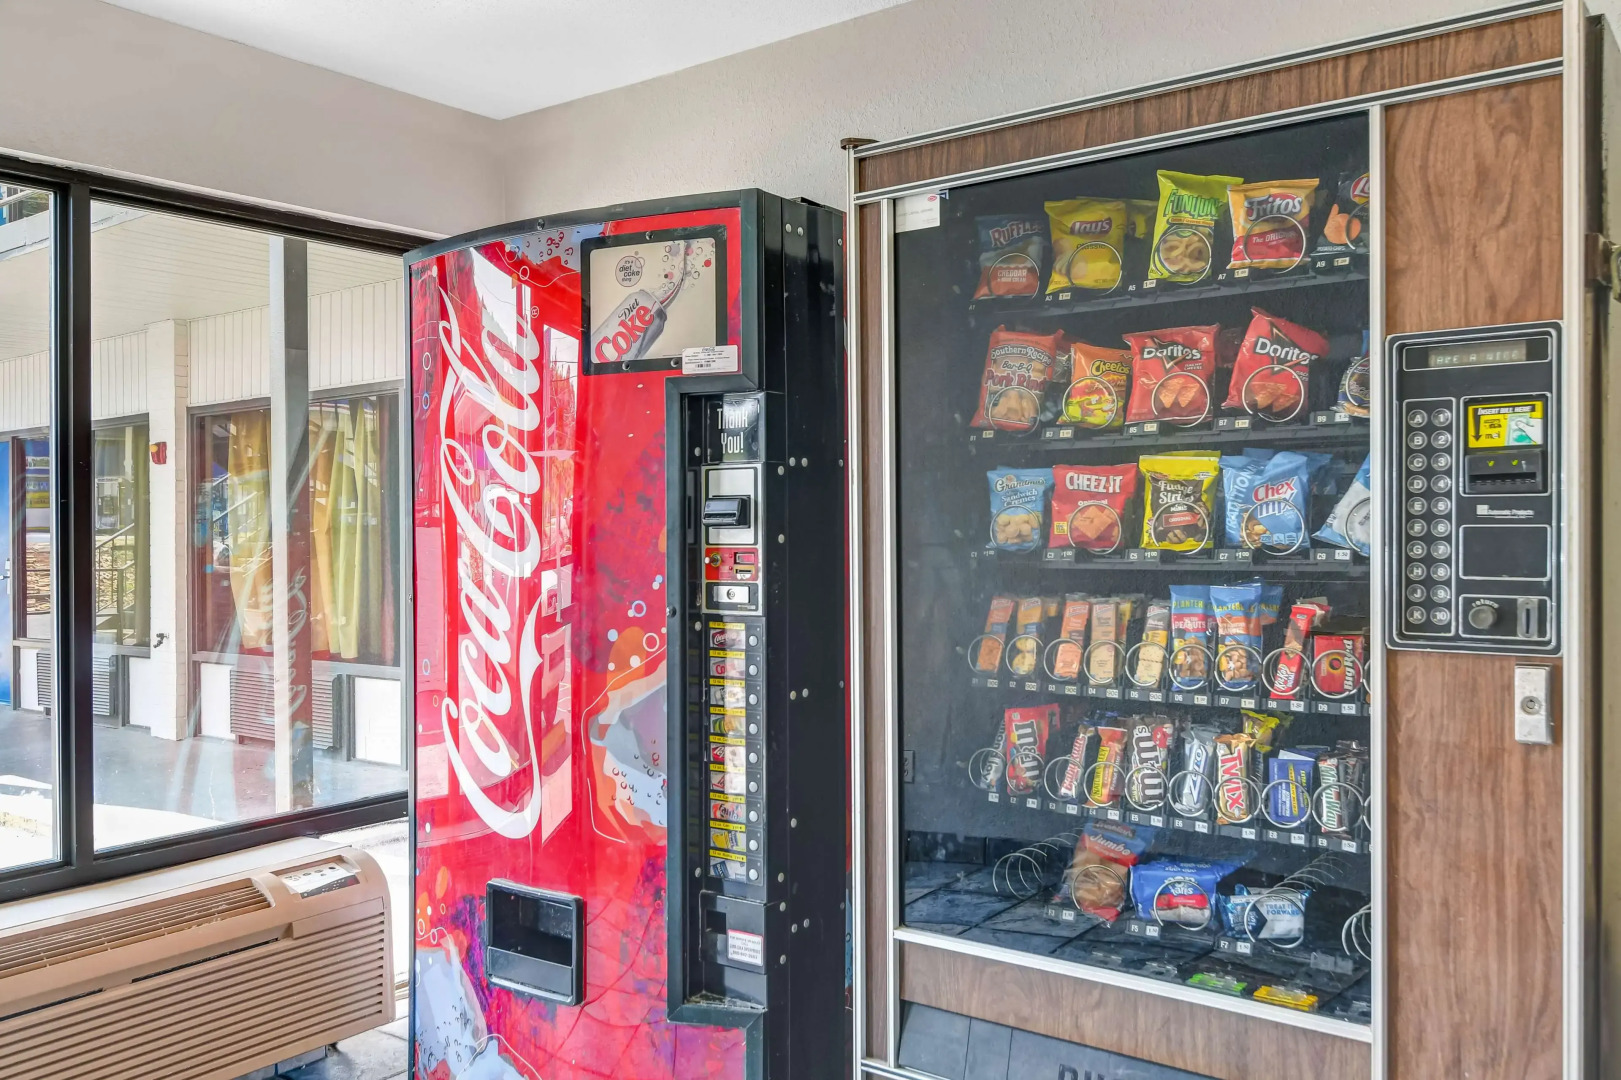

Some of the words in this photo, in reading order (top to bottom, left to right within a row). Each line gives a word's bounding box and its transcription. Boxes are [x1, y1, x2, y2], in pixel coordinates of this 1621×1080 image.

[1244, 195, 1302, 220] Fritos
[1074, 218, 1111, 234] Lay's
[997, 269, 1027, 277] CHEDDAR
[618, 298, 640, 320] Diet
[595, 304, 655, 362] Coke
[991, 346, 1027, 360] Southern
[1026, 346, 1053, 366] Recipe
[1143, 344, 1201, 360] Doritos
[1001, 360, 1033, 374] Bar-B-Q
[1091, 359, 1130, 375] Cheetos
[985, 368, 1016, 388] Pork
[1478, 407, 1500, 416] INSERT
[717, 408, 749, 430] Thank
[1414, 414, 1422, 423] A
[1438, 413, 1444, 422] 1
[720, 432, 744, 455] You!
[1414, 436, 1423, 445] B
[1438, 435, 1446, 444] 2
[1414, 458, 1423, 467] C
[1438, 457, 1445, 466] 3
[1065, 472, 1124, 493] CHEEZ-IT
[1414, 480, 1422, 488] D
[1437, 479, 1444, 488] 4
[1158, 481, 1193, 494] Fudge
[1253, 480, 1296, 502] Chex
[1002, 489, 1038, 502] Sandwich
[1414, 502, 1423, 510] E
[1437, 502, 1445, 510] 5
[1414, 524, 1422, 532] F
[1437, 524, 1445, 532] 6
[1413, 545, 1422, 554] G
[1438, 546, 1445, 554] 7
[1413, 567, 1422, 576] H
[1437, 567, 1445, 576] 8
[1413, 589, 1421, 598] J
[1437, 589, 1445, 598] 9
[1471, 599, 1499, 609] return
[1413, 611, 1422, 619] K
[1435, 612, 1447, 620] 10
[1174, 621, 1206, 629] PEANUTS
[1343, 667, 1355, 691] Big
[1325, 799, 1341, 829] Way
[1090, 834, 1131, 856] Jumbo
[1319, 838, 1327, 846] E9
